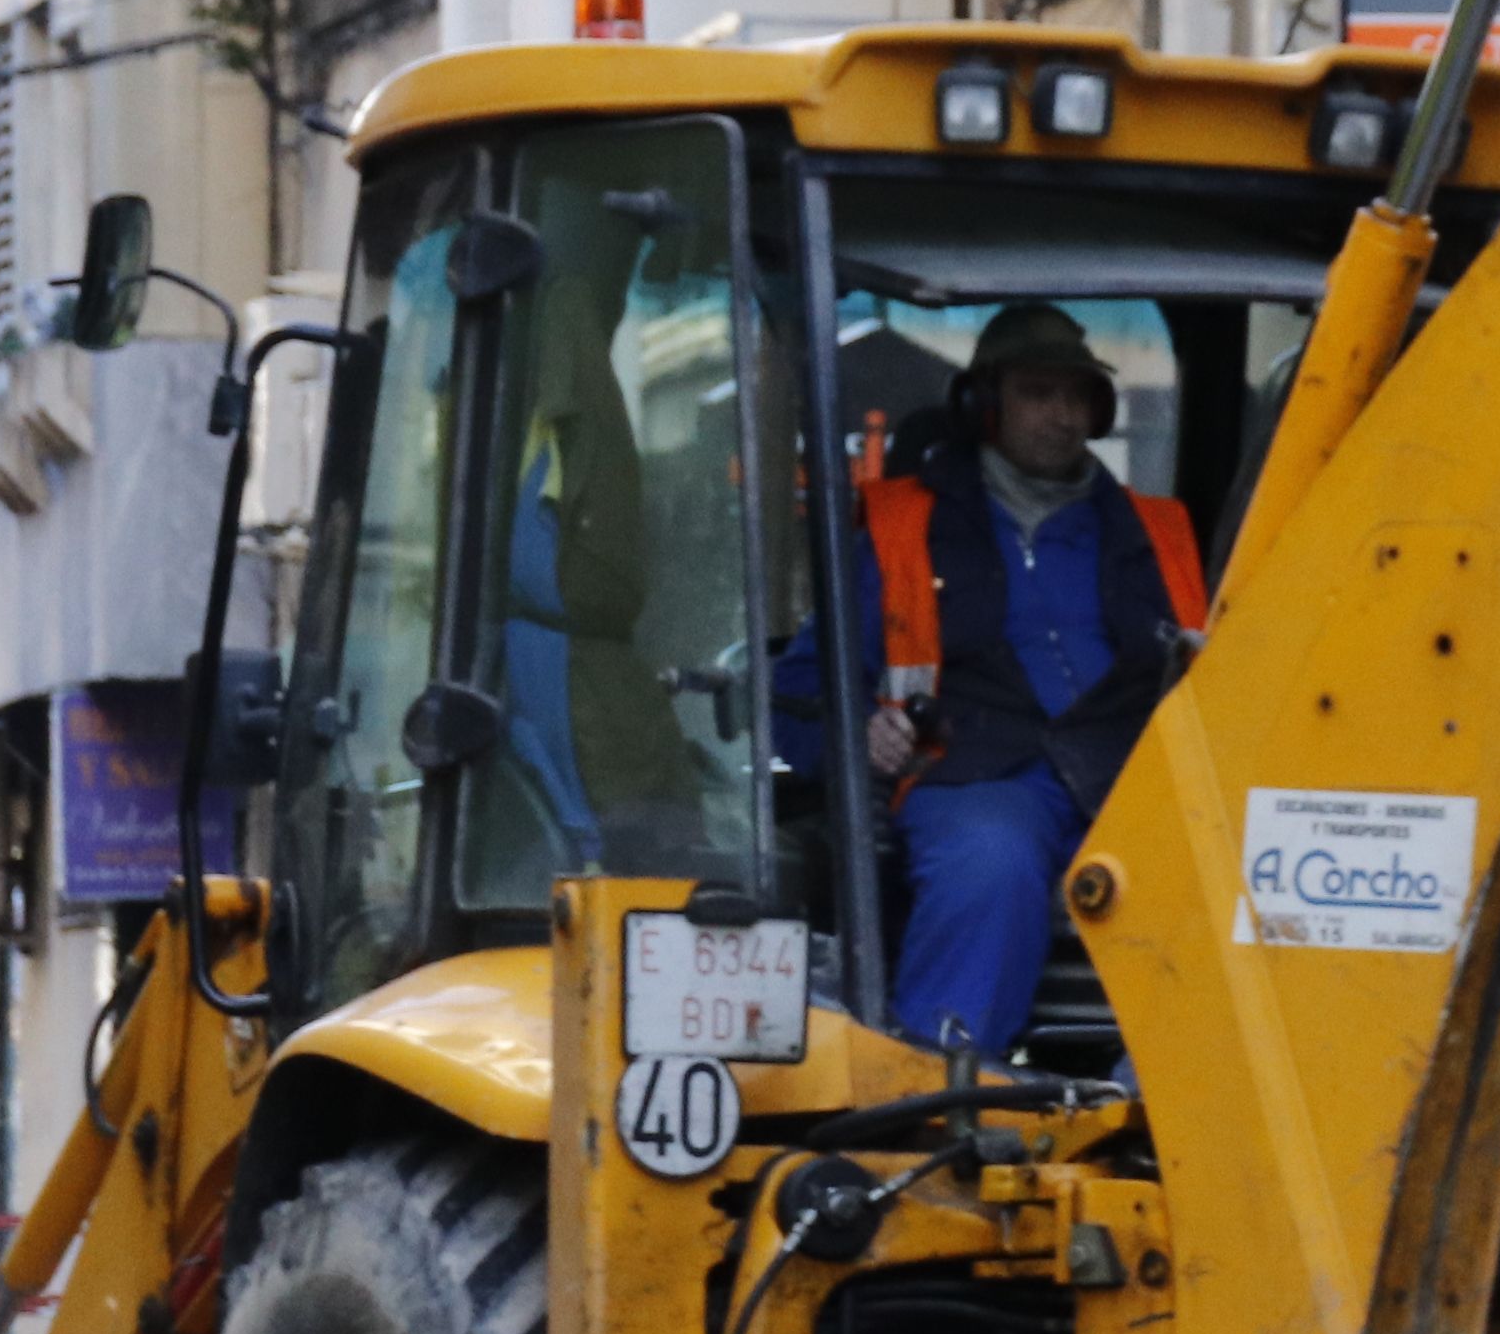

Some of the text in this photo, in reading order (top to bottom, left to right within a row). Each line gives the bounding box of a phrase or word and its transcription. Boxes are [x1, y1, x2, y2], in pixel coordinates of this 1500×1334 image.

[1323, 822, 1411, 839] TRANSPORTES
[1252, 847, 1441, 910] A. Corcho
[639, 929, 796, 977] E 6344
[631, 1059, 722, 1159] 40
